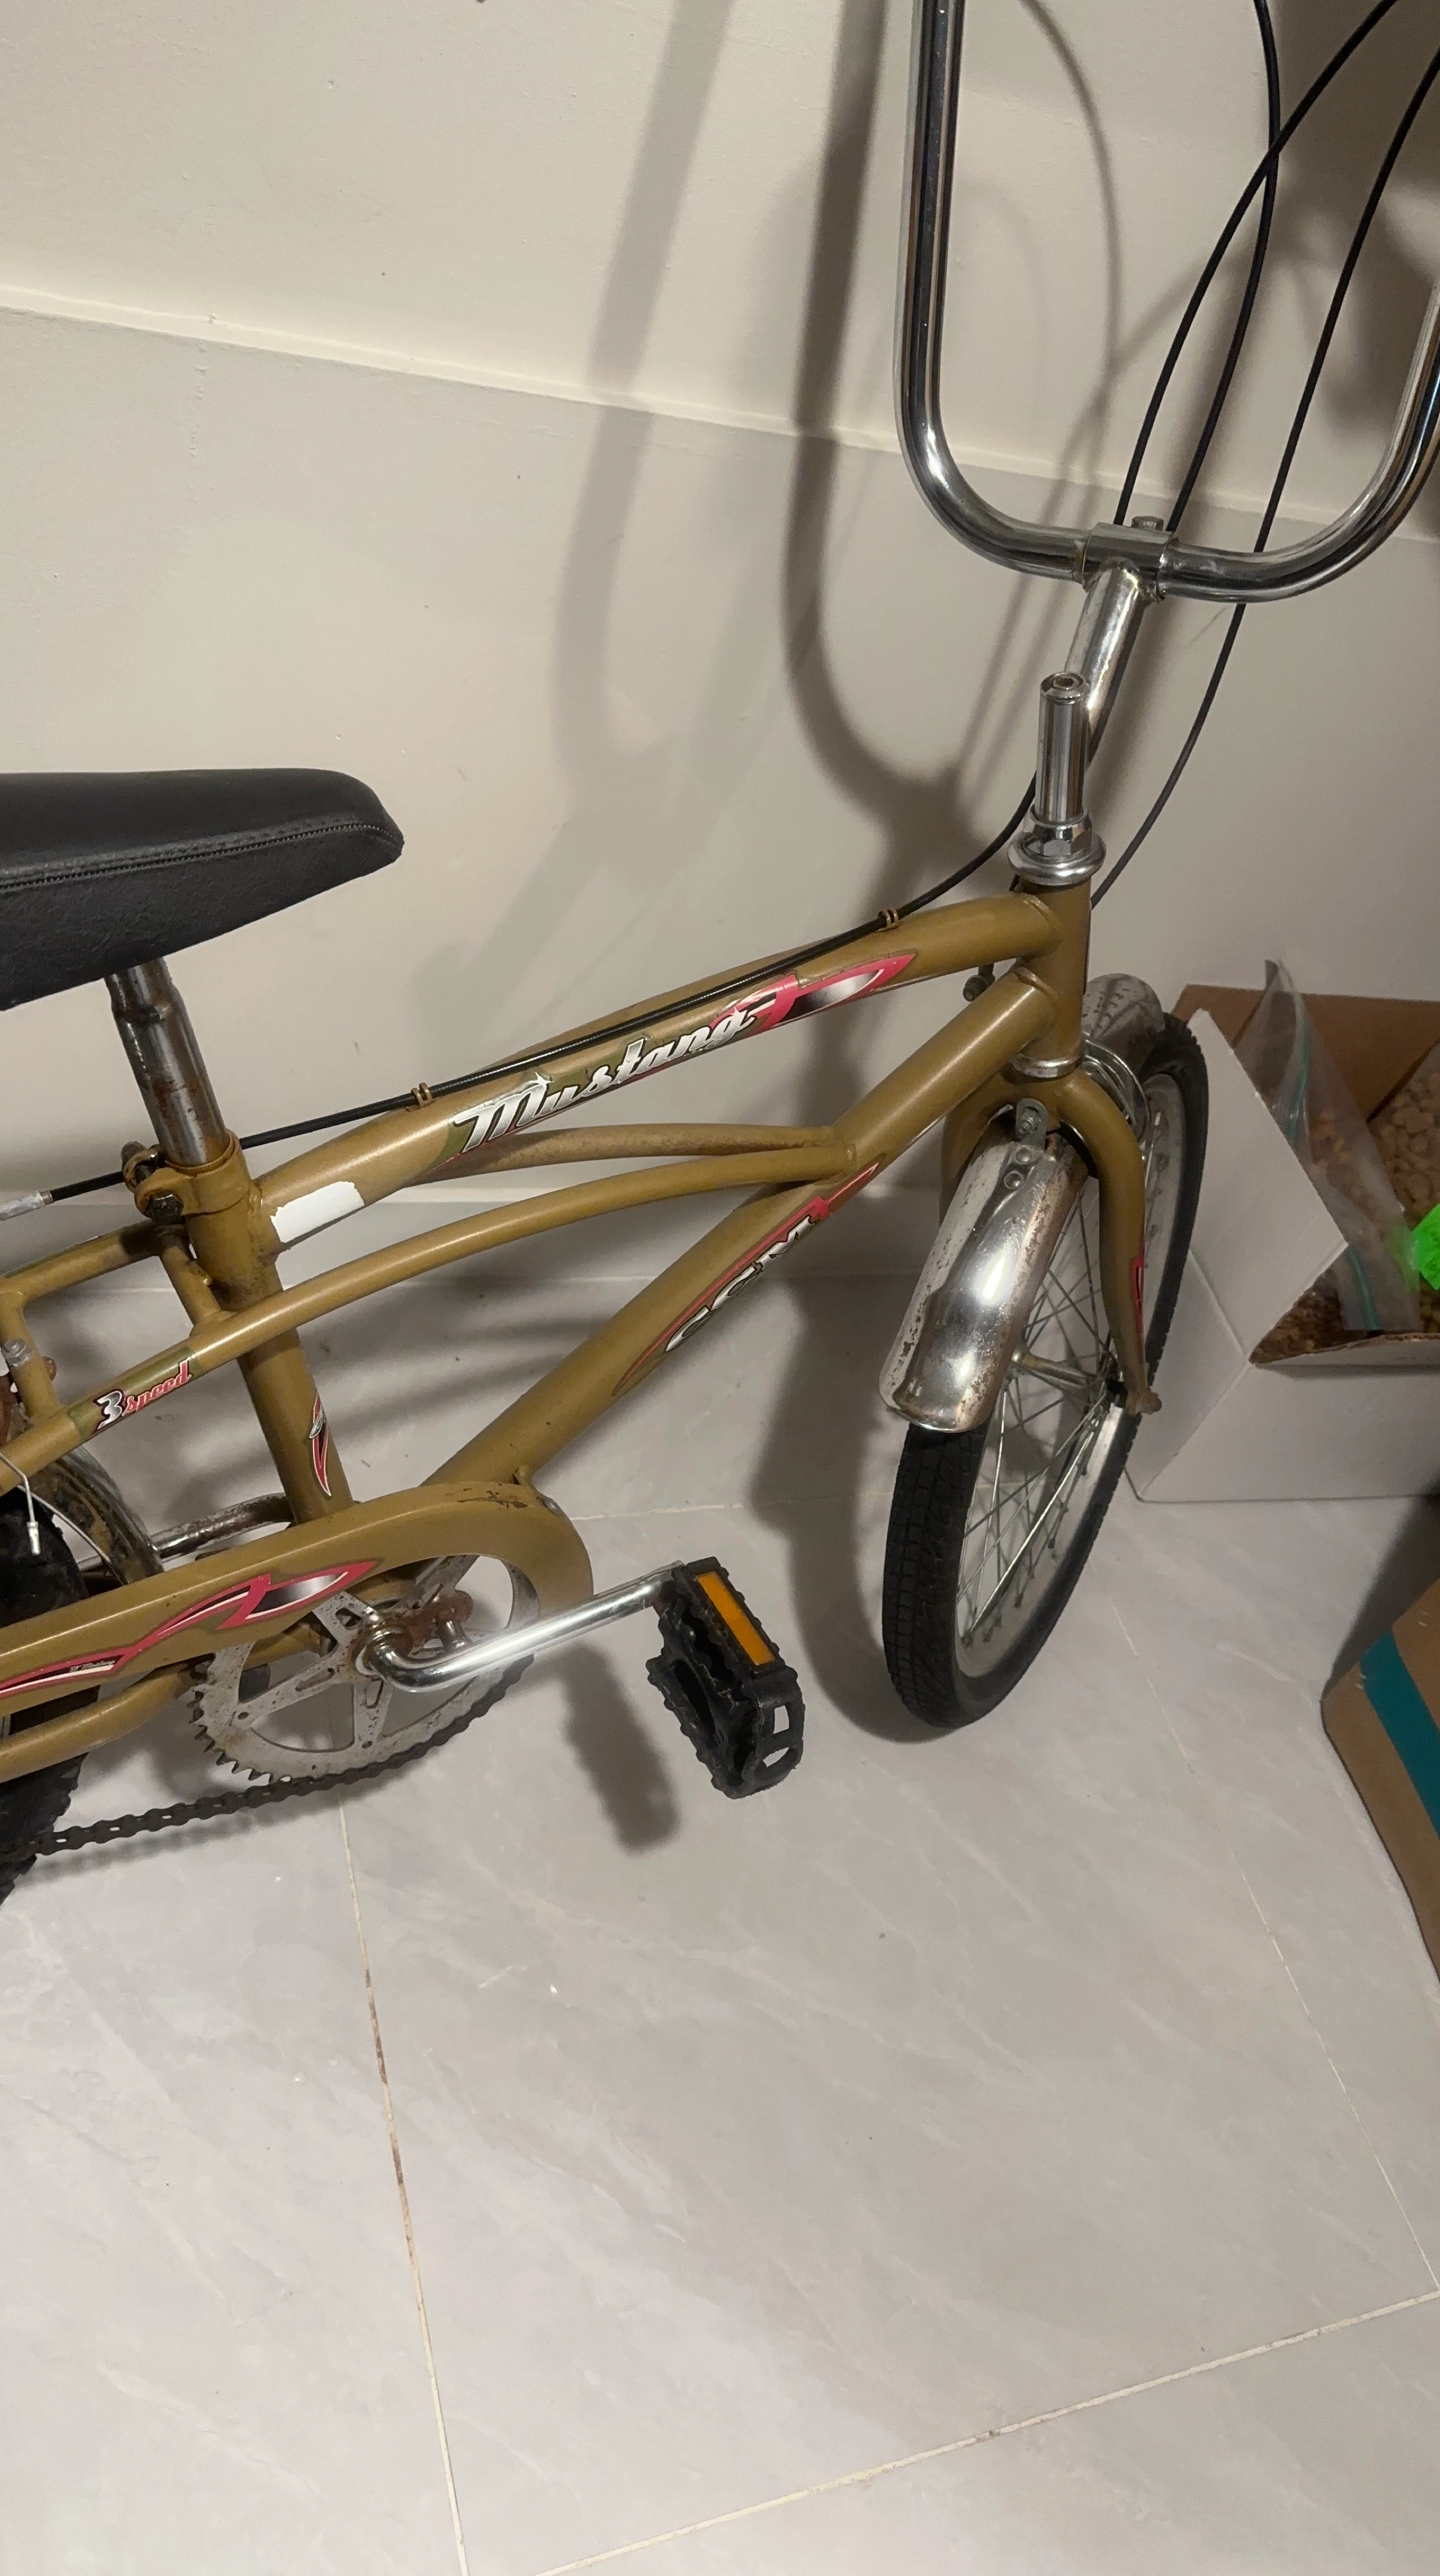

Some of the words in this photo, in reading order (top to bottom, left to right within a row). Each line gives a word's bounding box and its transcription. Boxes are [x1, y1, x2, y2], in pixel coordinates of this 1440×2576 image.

[451, 1006, 756, 1153] Mustang
[97, 1390, 122, 1430] 3
[122, 1360, 193, 1417] speed
